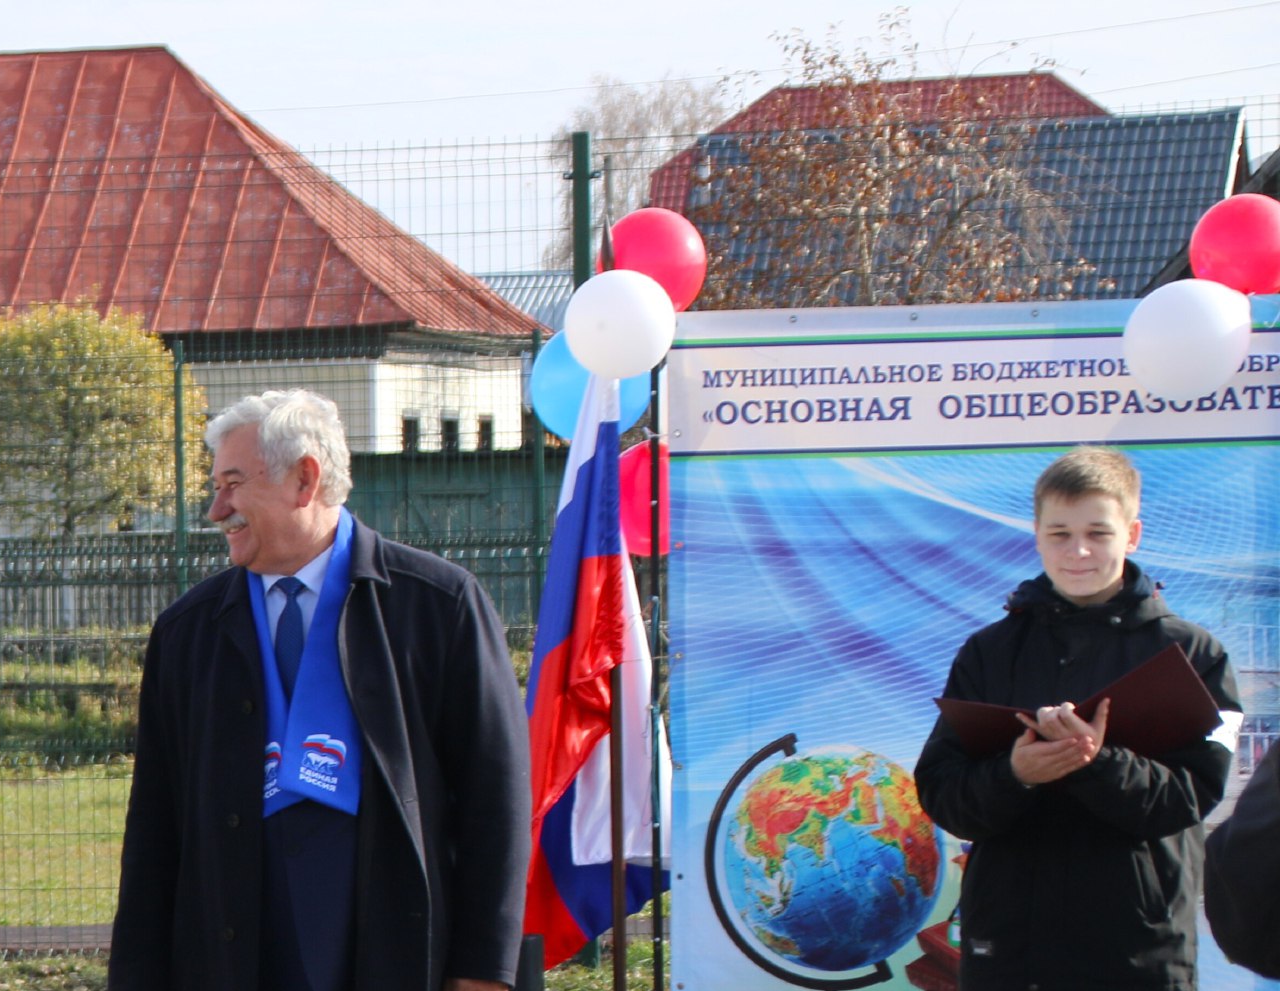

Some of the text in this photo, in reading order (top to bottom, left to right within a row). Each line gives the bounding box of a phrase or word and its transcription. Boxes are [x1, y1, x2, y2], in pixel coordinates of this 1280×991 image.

[702, 364, 943, 388] МУНИЦИПАЛЬНОЕ
[952, 358, 1131, 382] БЮДЖЕТНОЕ
[702, 396, 912, 425] «ОСНОВНАЯ
[299, 773, 337, 792] РОССИЯ
[300, 766, 338, 784] ЕДИНАЯ
